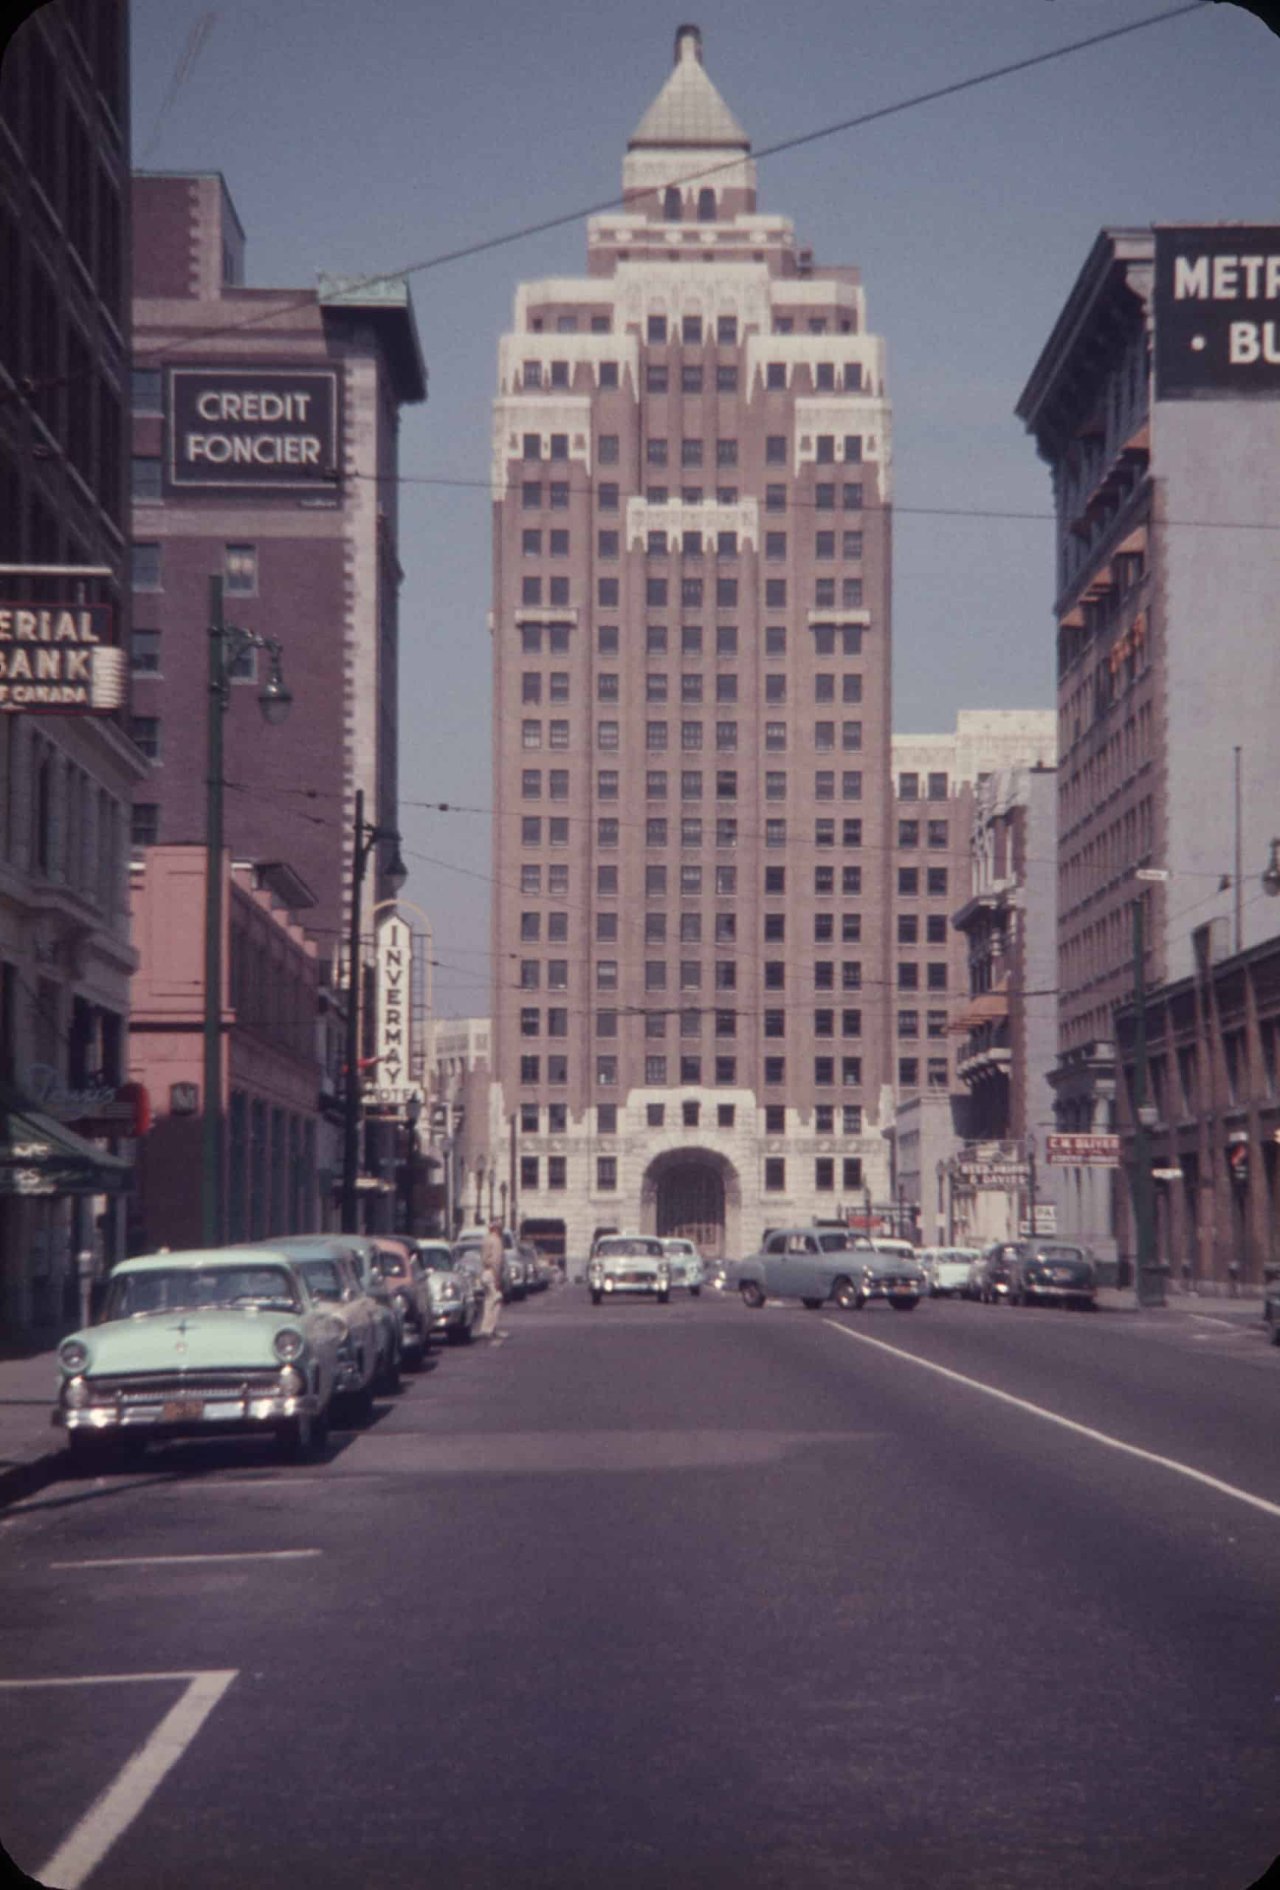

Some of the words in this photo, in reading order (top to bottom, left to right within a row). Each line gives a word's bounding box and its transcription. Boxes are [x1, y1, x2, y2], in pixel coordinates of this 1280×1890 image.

[198, 392, 311, 421] CREDIT
[187, 435, 321, 464] FONCIER
[0, 609, 100, 642] ERIAL
[12, 684, 88, 703] CANADA
[386, 925, 402, 1084] INVERMAY
